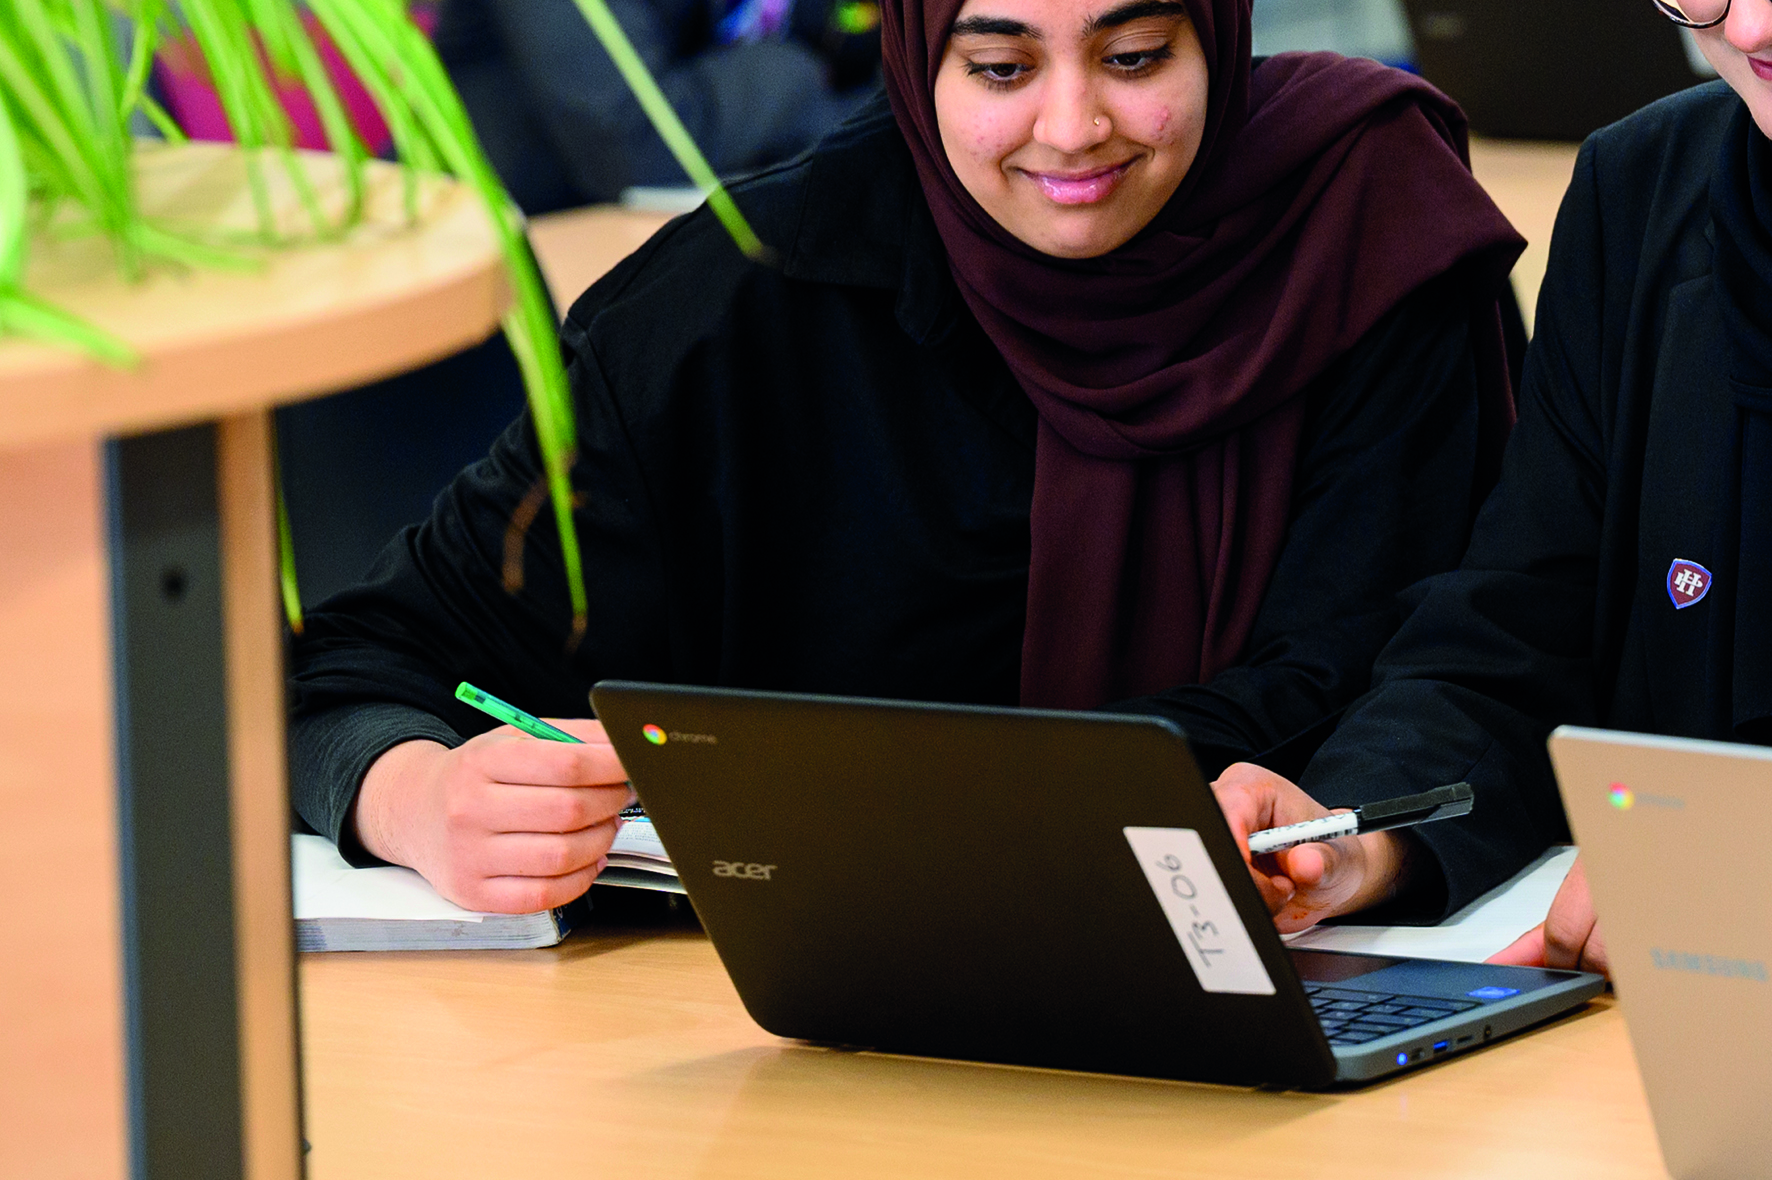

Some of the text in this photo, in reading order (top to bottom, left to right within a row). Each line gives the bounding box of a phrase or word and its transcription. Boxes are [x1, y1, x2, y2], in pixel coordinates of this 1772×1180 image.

[712, 859, 778, 881] acer
[1155, 853, 1226, 968] T3-06
[1650, 946, 1769, 983] SAMSUNG
